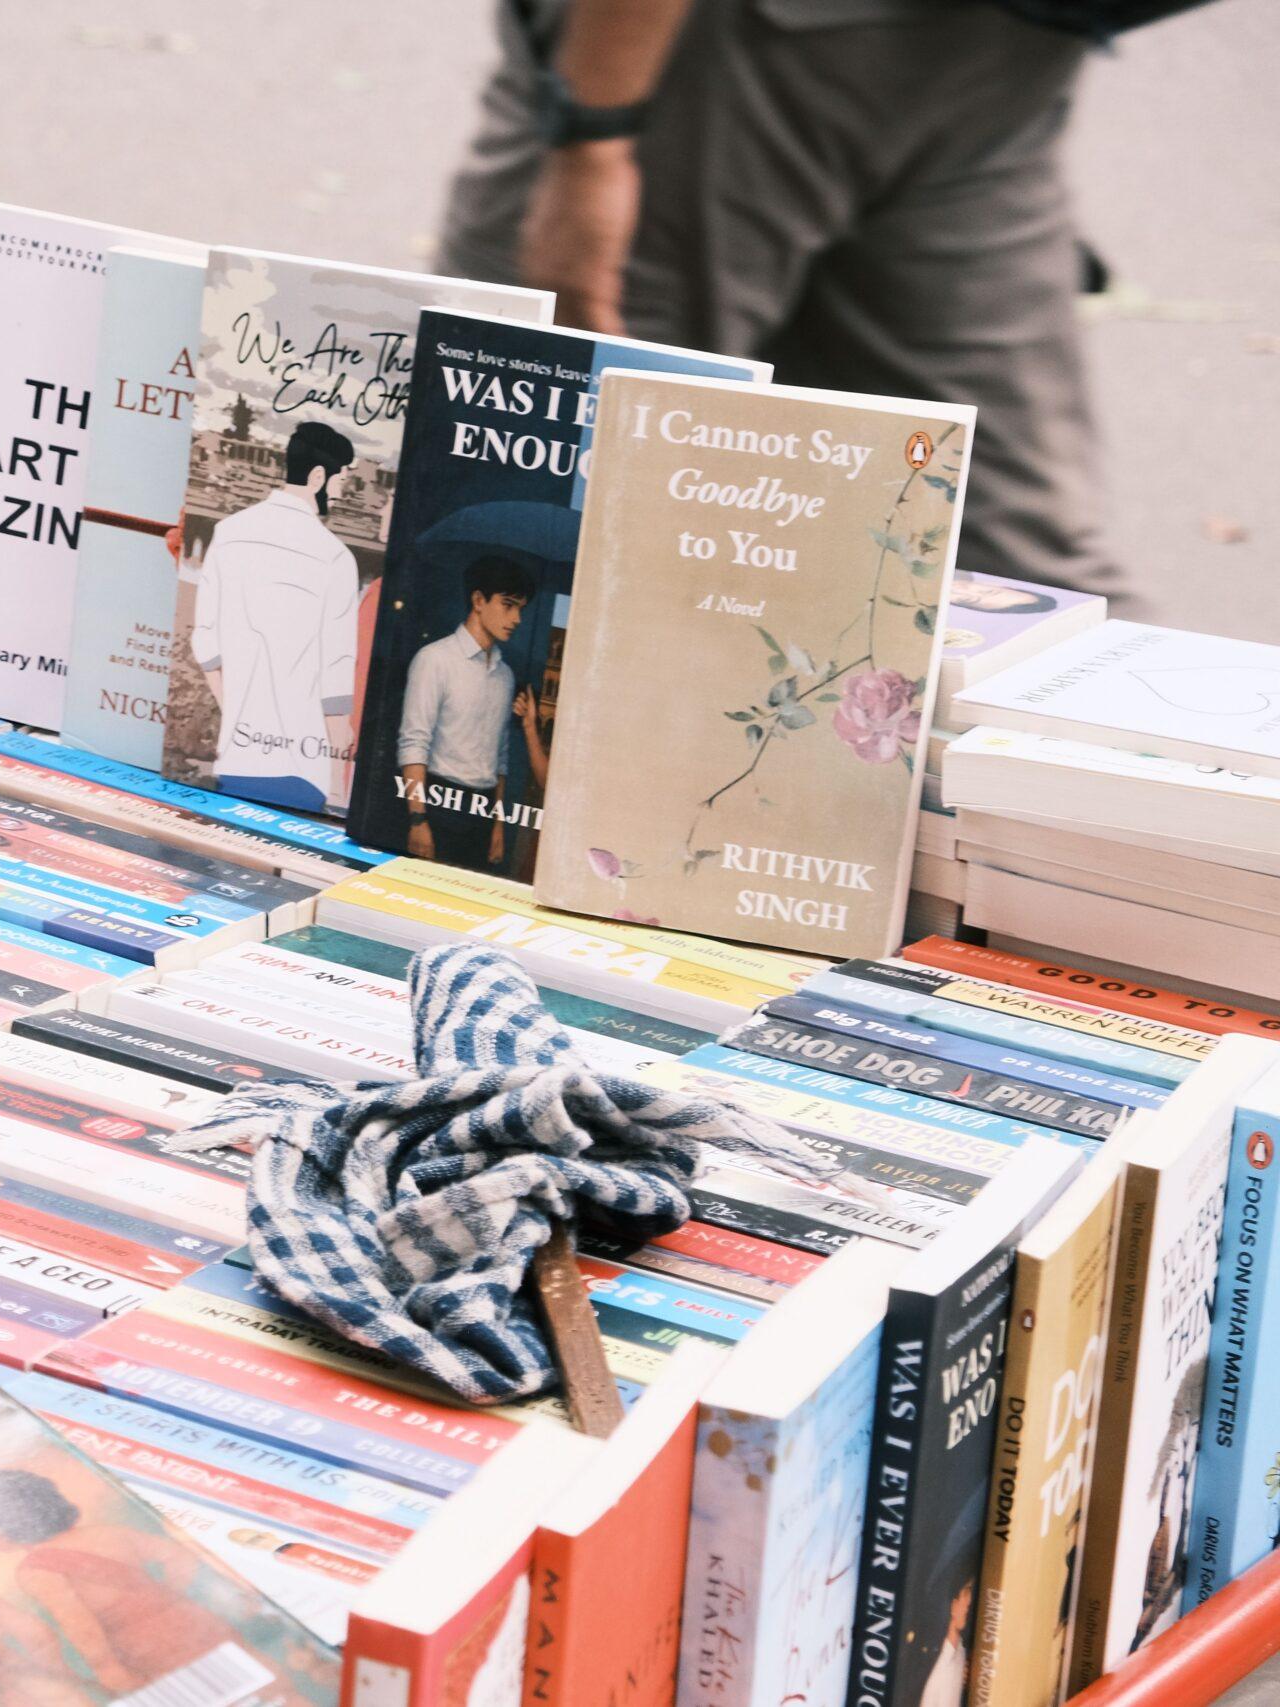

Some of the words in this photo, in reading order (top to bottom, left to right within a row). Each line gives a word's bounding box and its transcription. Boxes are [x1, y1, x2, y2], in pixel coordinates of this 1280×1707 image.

[232, 312, 295, 365] We
[304, 323, 364, 376] Are
[436, 341, 474, 362] Some
[476, 348, 506, 368] love
[508, 356, 552, 376] stories
[554, 364, 590, 382] leave
[25, 378, 91, 429] TH
[272, 364, 347, 413] Each
[439, 366, 536, 415] WAS
[543, 386, 562, 421] I
[631, 404, 653, 439] I
[659, 410, 802, 460] Cannot
[807, 429, 875, 481] Say
[667, 467, 826, 528] Goodbye
[678, 530, 716, 559] to
[726, 530, 798, 573] You
[134, 622, 170, 642] Move
[716, 595, 767, 619] Novel
[108, 651, 135, 667] and
[125, 637, 157, 656] Find
[100, 687, 168, 726] NICK
[232, 722, 295, 757] Sagar
[220, 801, 276, 828] JOHN
[279, 818, 349, 845] GREEN
[393, 775, 463, 812] YASH
[467, 790, 543, 831] RAJIT
[719, 842, 877, 893] RITHVIK
[67, 911, 154, 941] HENRY
[349, 879, 383, 898] the
[384, 890, 492, 925] personal
[469, 912, 673, 984] MBA
[735, 889, 849, 932] SINGH
[239, 951, 311, 974] CRIME
[305, 970, 359, 987] AND
[1036, 966, 1159, 999] GOOD
[1185, 999, 1238, 1019] TO
[182, 998, 239, 1018] ONE
[238, 1014, 280, 1029] OF
[275, 1025, 317, 1041] US
[316, 1036, 352, 1051] IS
[586, 1013, 638, 1034] ANA
[841, 979, 917, 1005] WHY
[938, 1005, 993, 1026] AM
[1020, 1020, 1138, 1058] HINDU
[988, 992, 1116, 1031] WARREN
[49, 1013, 120, 1041] HARUKI
[119, 1033, 223, 1070] MURAKAMI
[814, 1007, 859, 1029] Big
[862, 1019, 938, 1047] Trust
[998, 1056, 1032, 1070] DR
[753, 1027, 857, 1066] SHOE
[855, 1051, 944, 1087] DOG
[984, 1083, 1067, 1119] PHIL
[854, 1086, 911, 1107] AND
[902, 1099, 1000, 1139] SINKER
[871, 1160, 942, 1187] TAYLOR
[822, 1200, 922, 1236] COLLEEN
[1239, 1175, 1263, 1247] FOCUS
[40, 1262, 115, 1292] CEO
[1126, 1226, 1144, 1280] Become
[1235, 1251, 1254, 1285] ON
[671, 1298, 738, 1321] EMILY
[1227, 1287, 1251, 1355] WHAT
[198, 1306, 306, 1343] INTRADAY
[304, 1335, 396, 1371] TRADING
[888, 1339, 925, 1422] WAS
[939, 1331, 993, 1404] WAS
[106, 1360, 291, 1437] NOVEMBER
[334, 1390, 403, 1421] THE
[1007, 1394, 1026, 1431] DO
[1215, 1352, 1243, 1448] MATTERS
[94, 1399, 208, 1446] STARTS
[213, 1432, 301, 1472] WITH
[302, 1462, 350, 1488] US
[353, 1438, 468, 1482] COLLEEN
[128, 1449, 242, 1493] PATIENT
[871, 1465, 910, 1573] EVER
[992, 1464, 1021, 1542] TODAY
[1202, 1516, 1220, 1565] DARIUS
[696, 1552, 725, 1689] KHALED
[982, 1587, 1006, 1655] DARIUS
